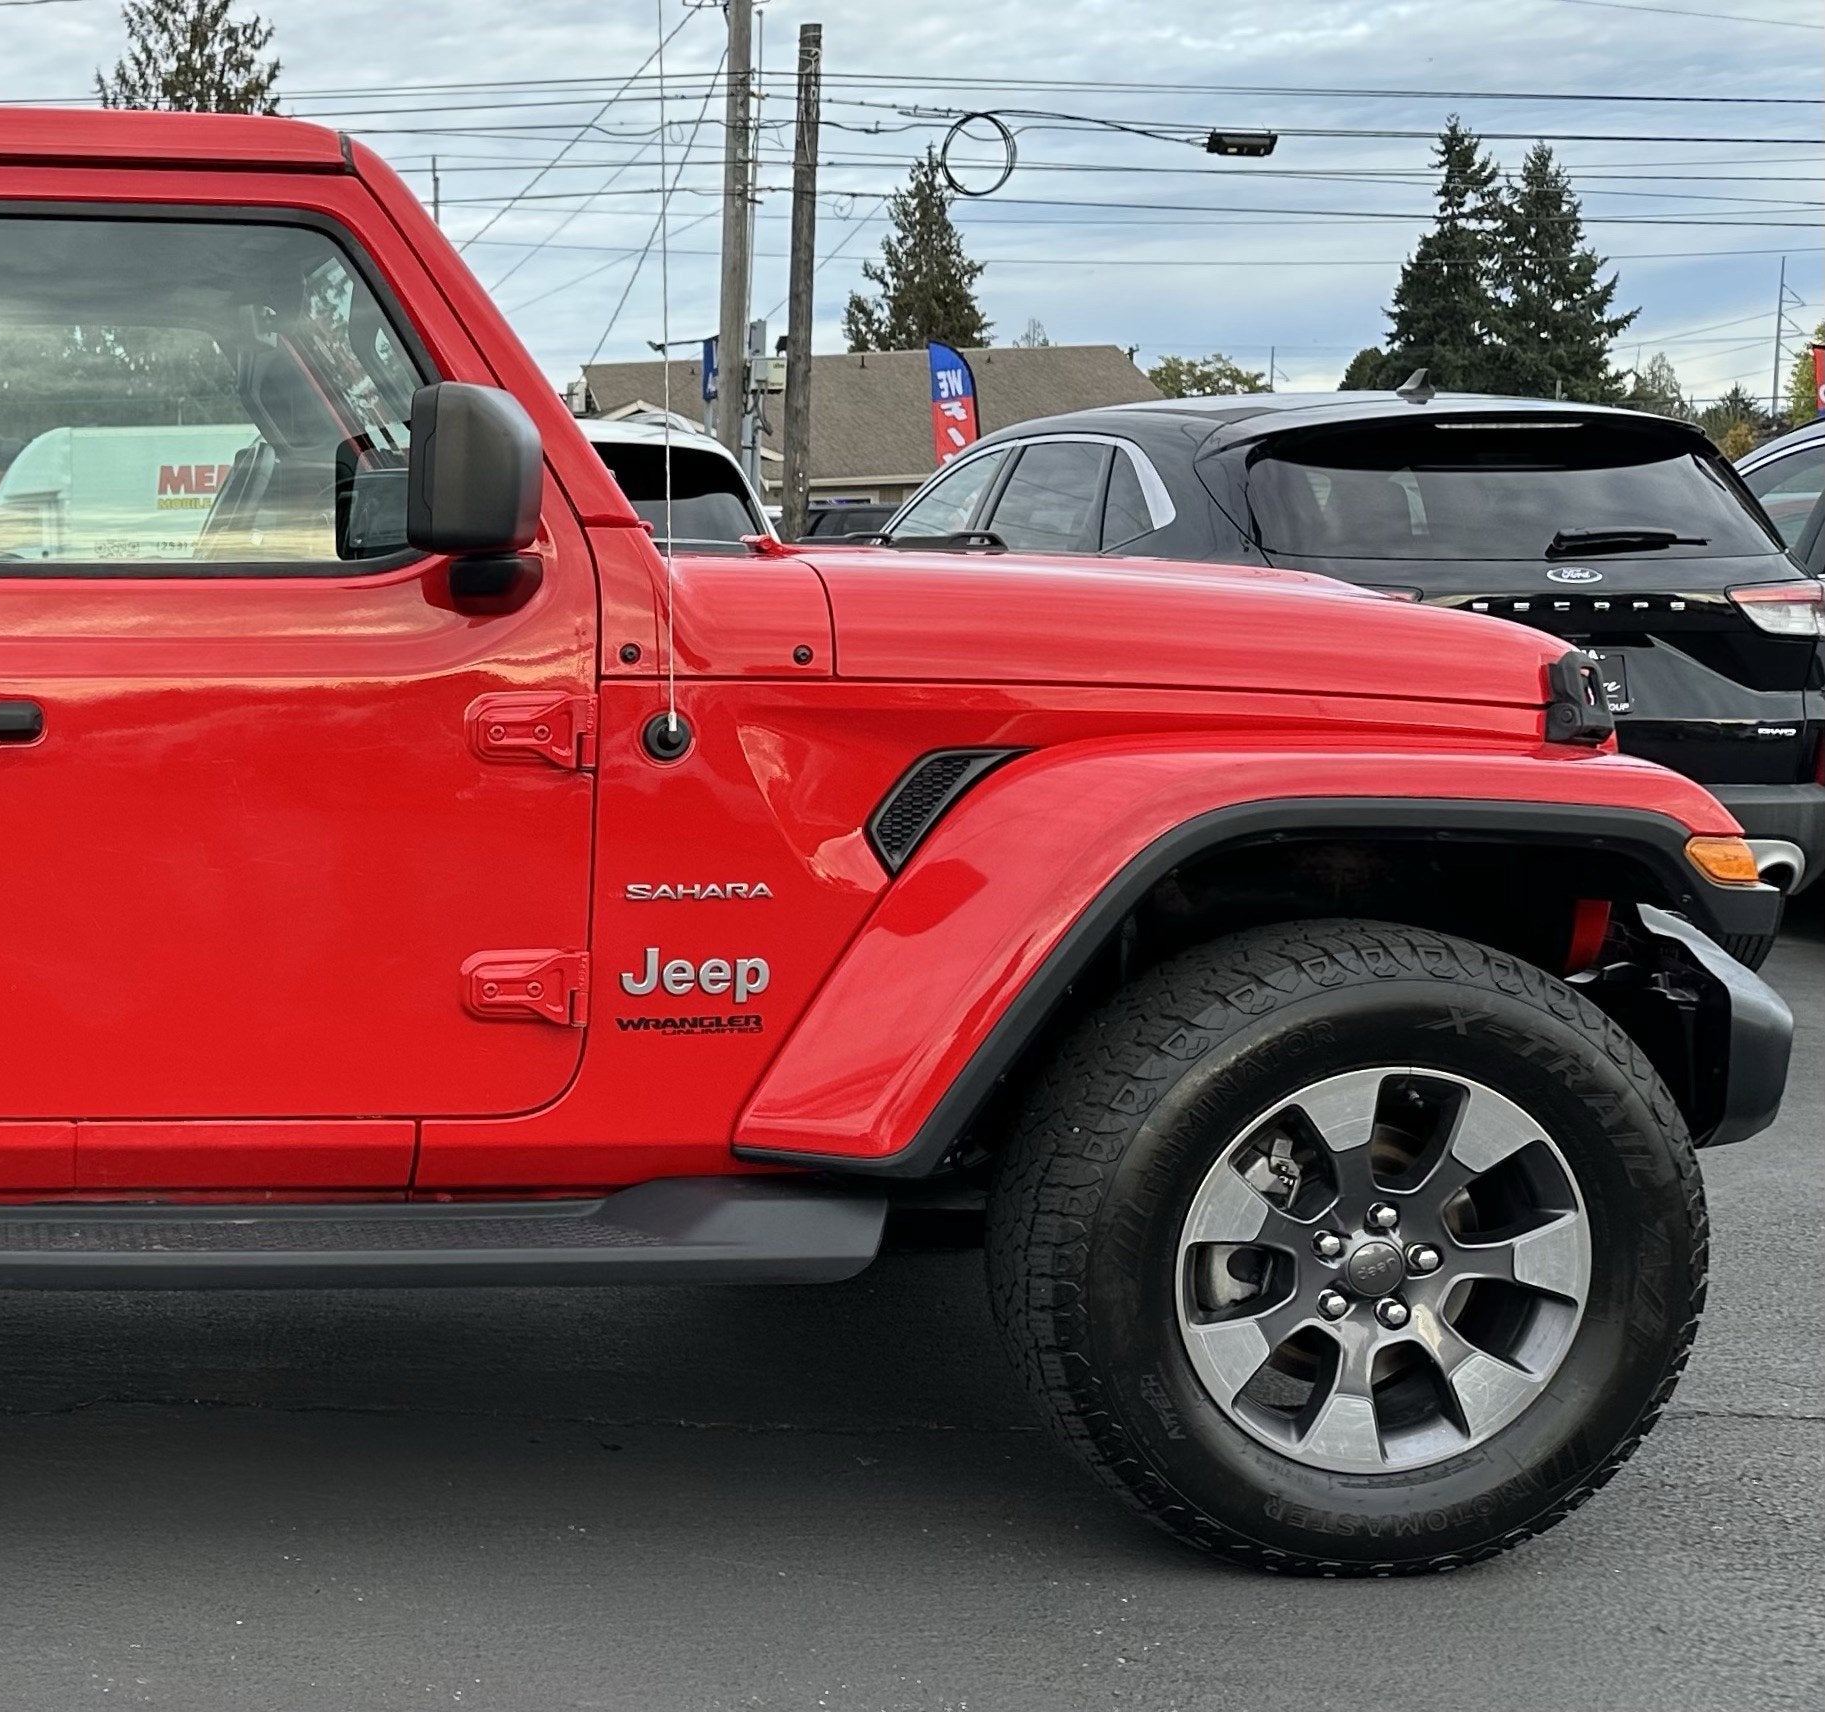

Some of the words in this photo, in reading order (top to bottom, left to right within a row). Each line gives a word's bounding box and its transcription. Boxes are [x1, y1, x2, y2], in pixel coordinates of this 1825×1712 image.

[157, 498, 212, 510] MOBILE
[625, 882, 774, 900] SAHARA
[620, 947, 771, 1003] Jeep
[615, 1014, 763, 1032] WRANGLER
